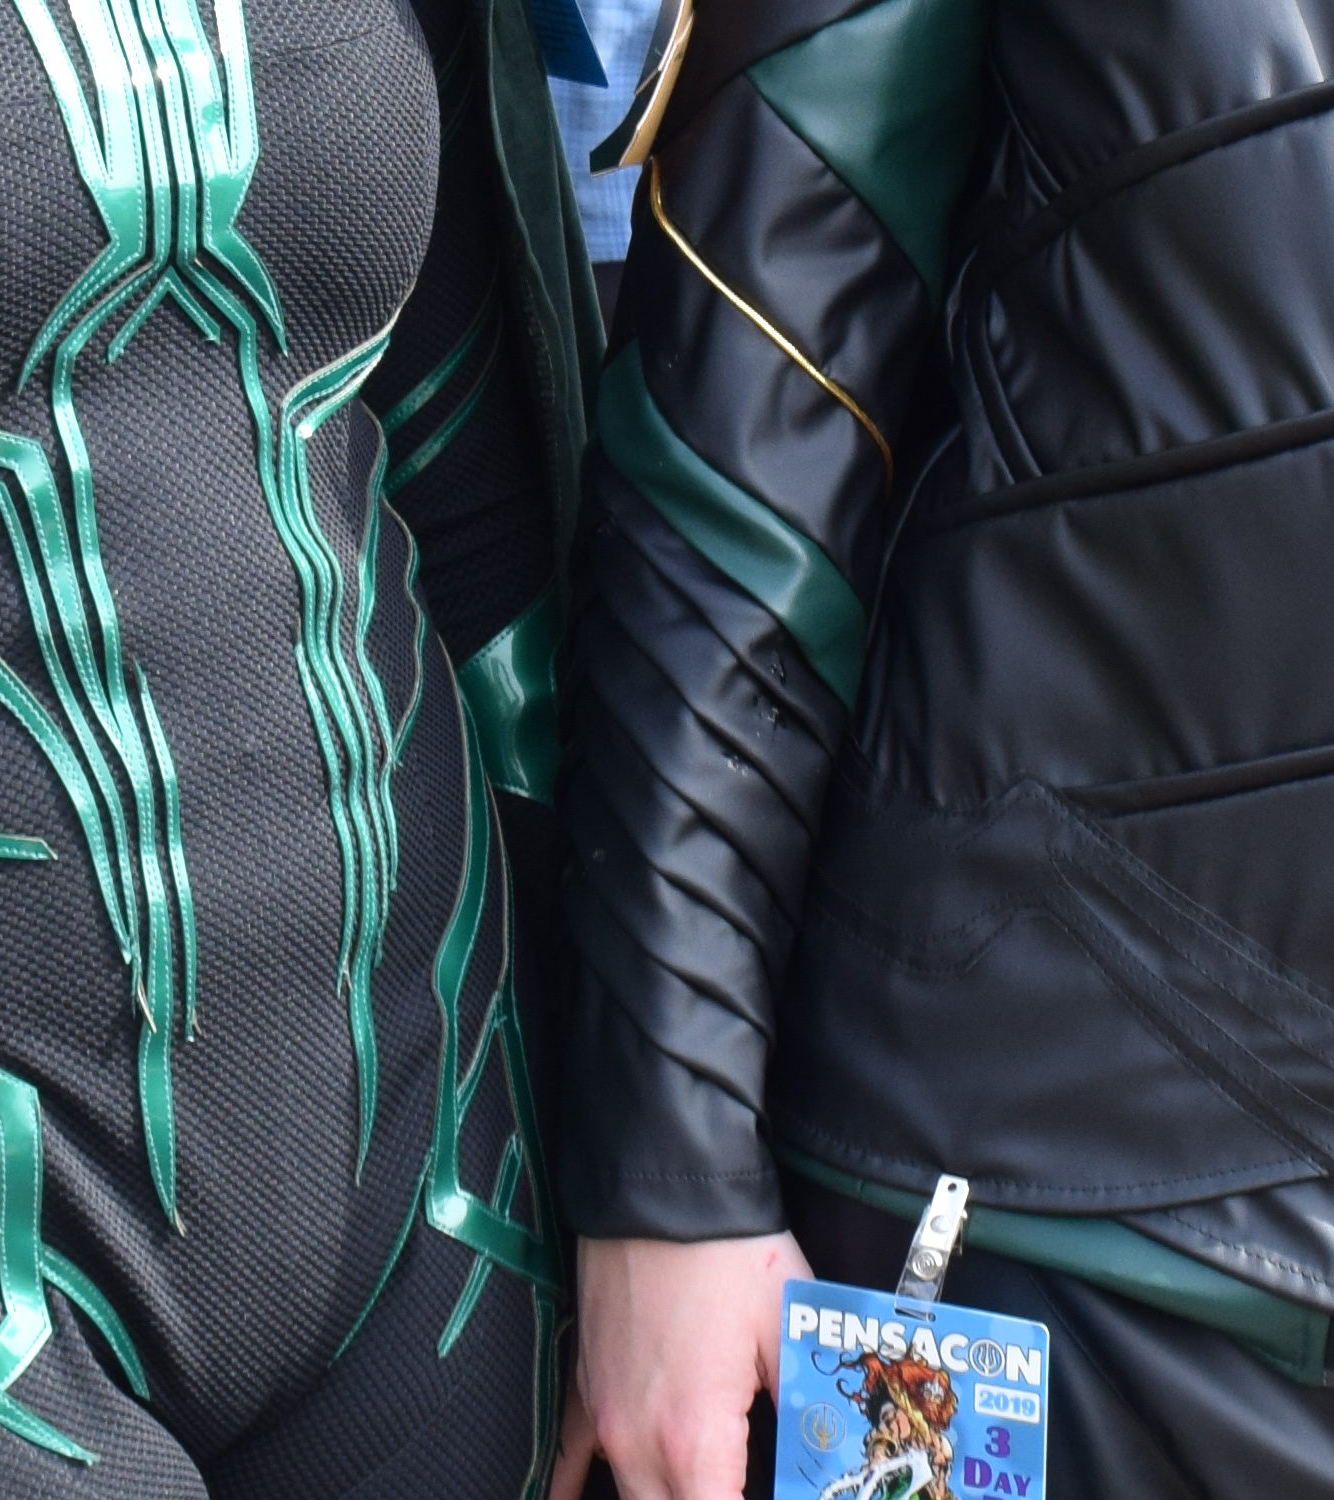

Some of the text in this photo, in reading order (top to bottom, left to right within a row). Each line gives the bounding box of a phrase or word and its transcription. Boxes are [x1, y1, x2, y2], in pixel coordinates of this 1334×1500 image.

[788, 1302, 1042, 1387] PENSACON
[978, 1388, 1037, 1419] 2019
[984, 1425, 1011, 1459] 3
